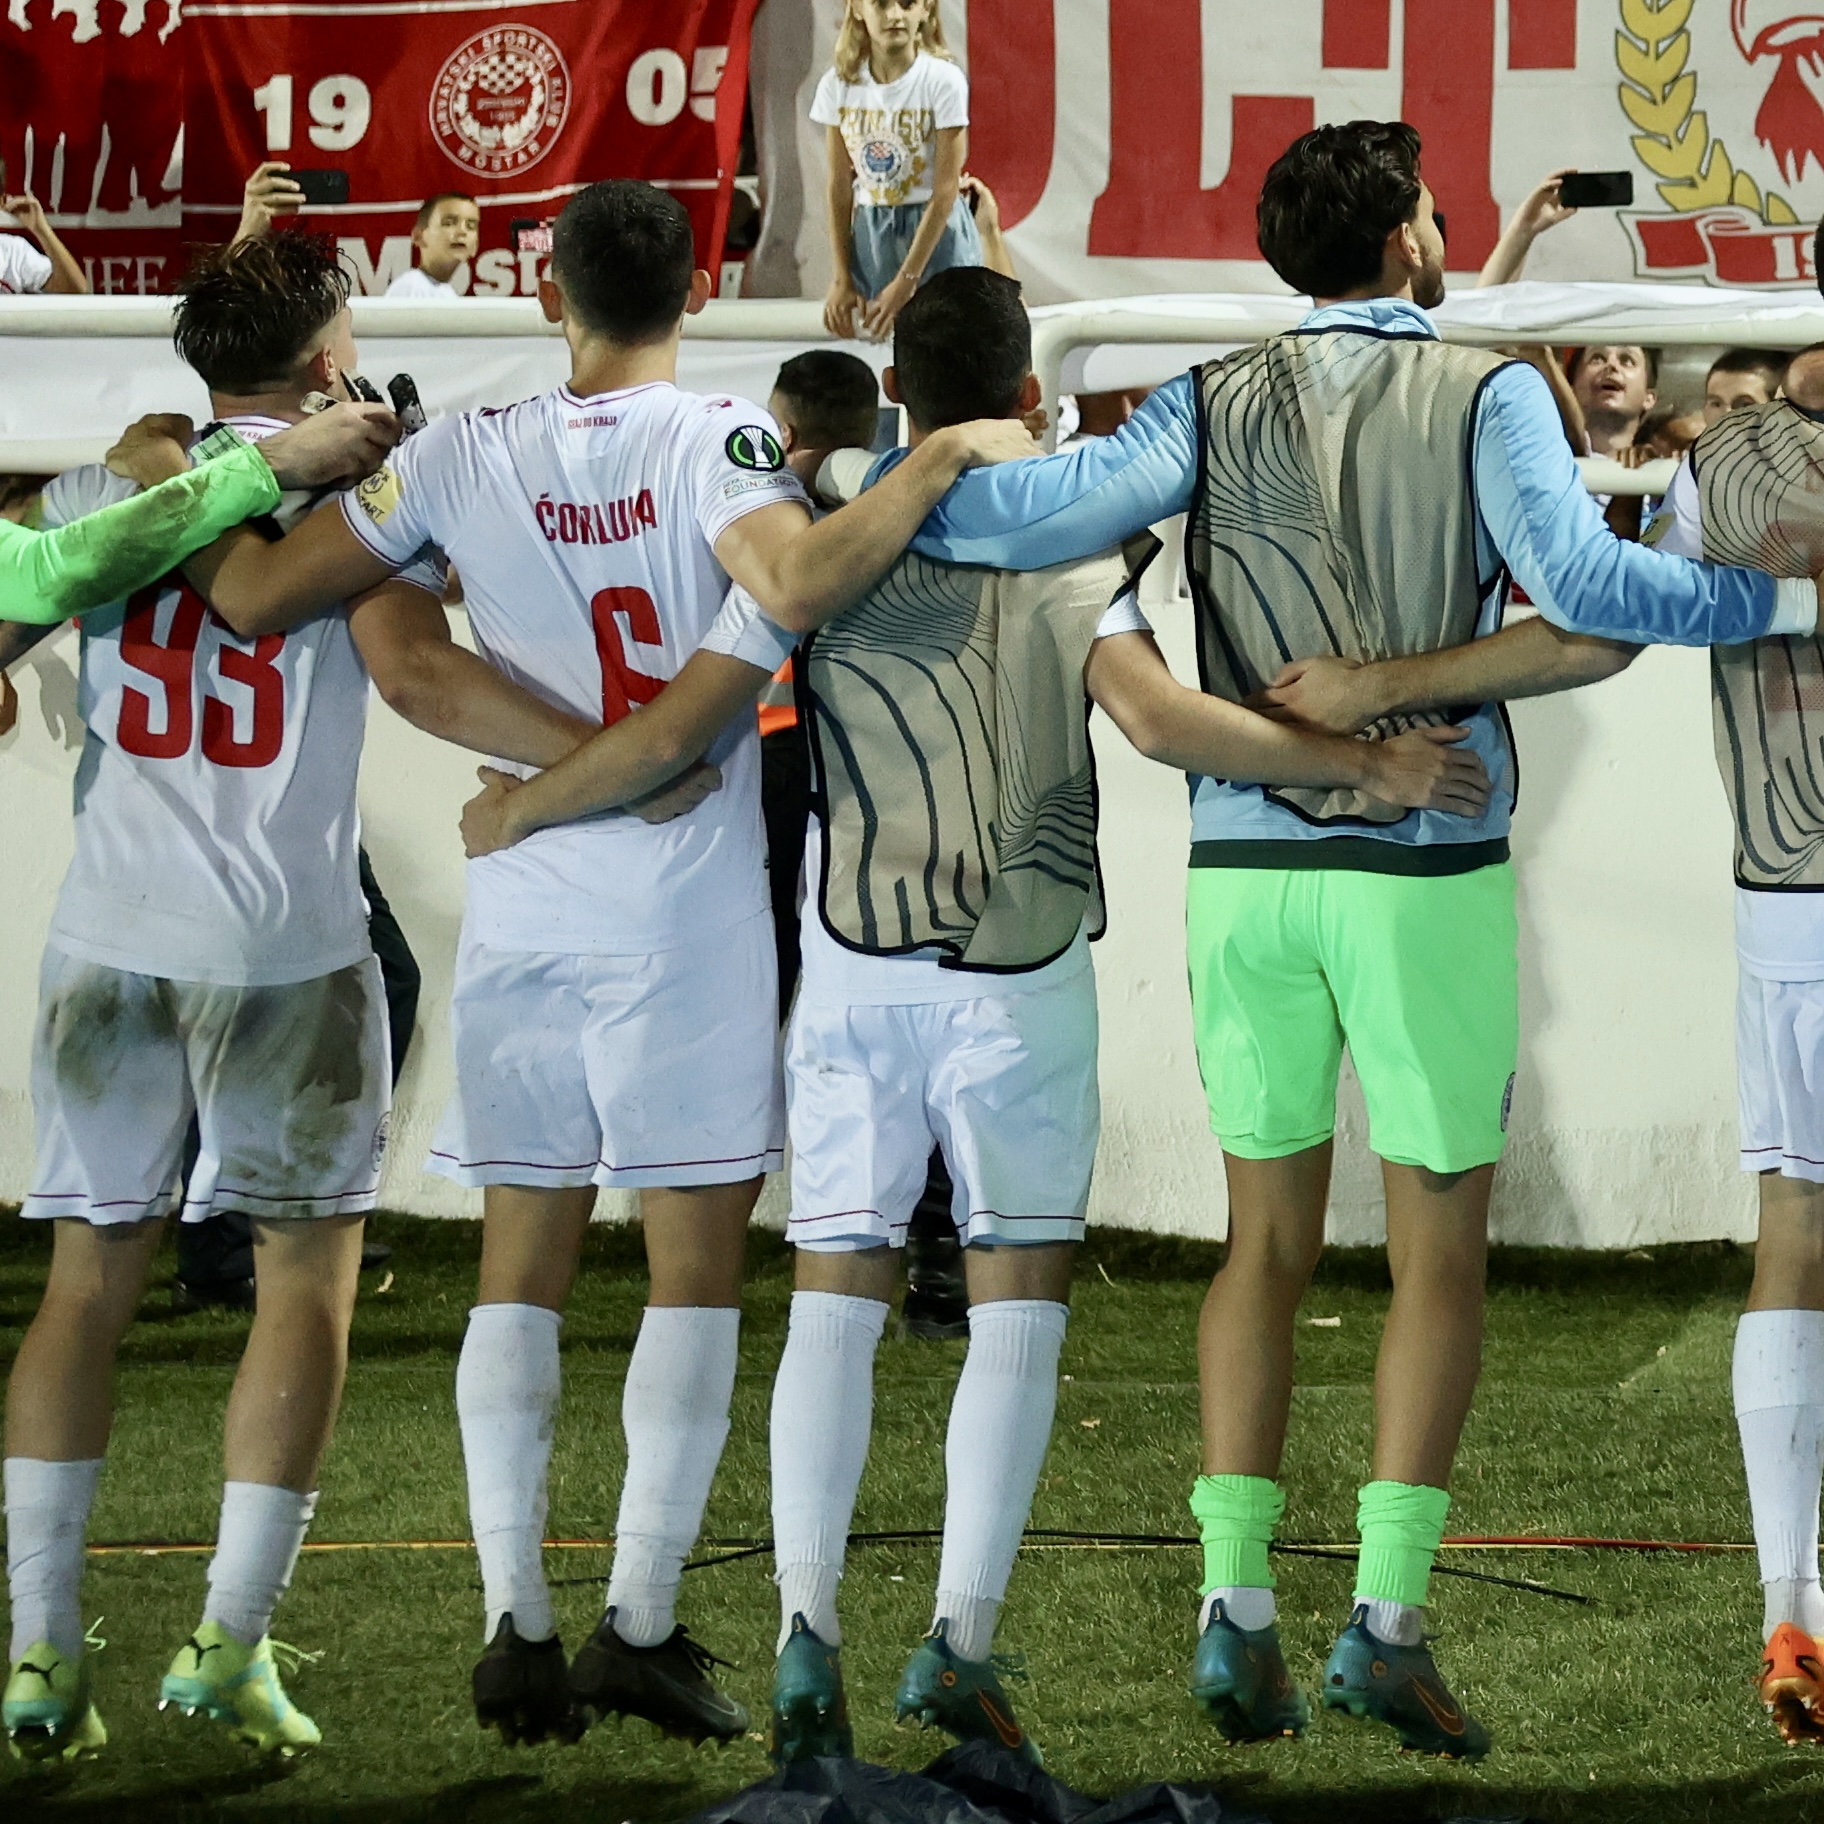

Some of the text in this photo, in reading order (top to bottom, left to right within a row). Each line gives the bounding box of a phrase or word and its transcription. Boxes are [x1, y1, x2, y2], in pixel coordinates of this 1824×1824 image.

[253, 73, 372, 152] 19
[457, 138, 541, 172] MOSTAR
[116, 570, 287, 770] 93
